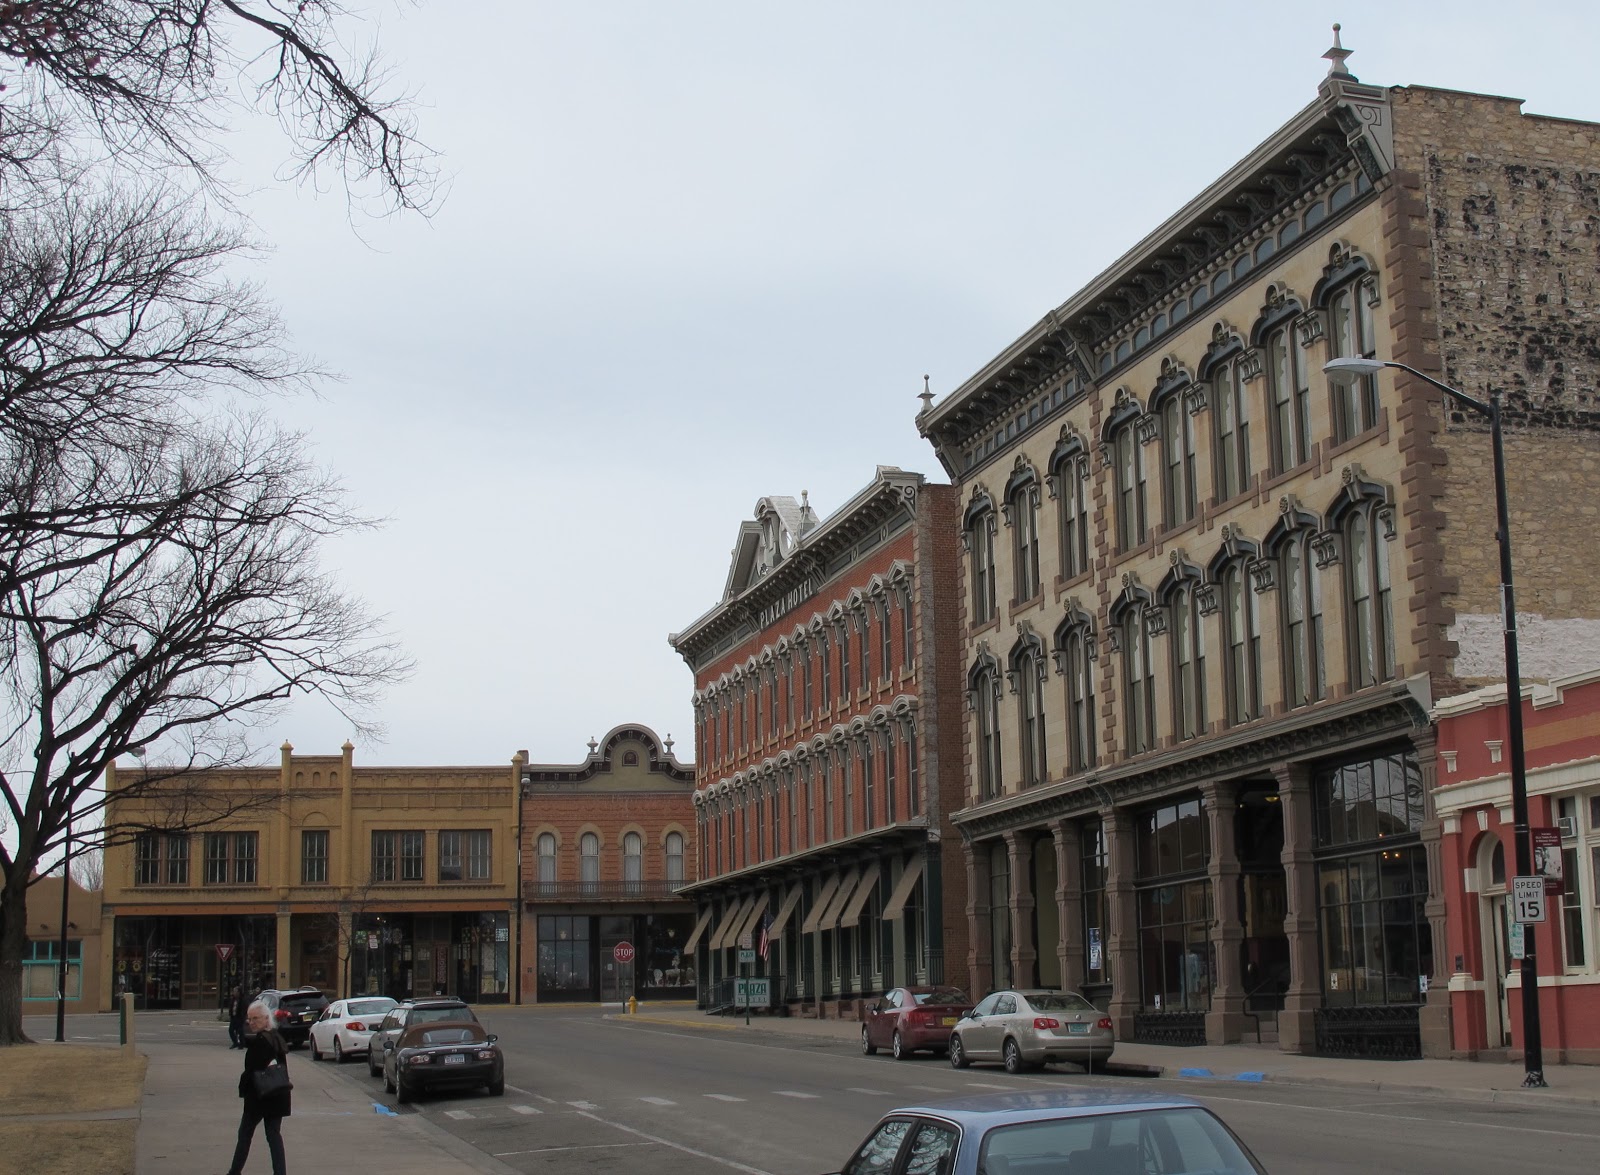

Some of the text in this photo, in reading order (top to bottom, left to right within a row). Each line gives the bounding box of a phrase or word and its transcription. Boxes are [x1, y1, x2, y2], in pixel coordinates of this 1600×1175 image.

[760, 578, 813, 630] PLAZA HOTEL
[1515, 881, 1541, 889] SPEED
[1518, 891, 1539, 899] LIMIT
[1520, 901, 1540, 918] 15
[615, 948, 633, 957] STOP
[738, 983, 767, 995] PLAZA
